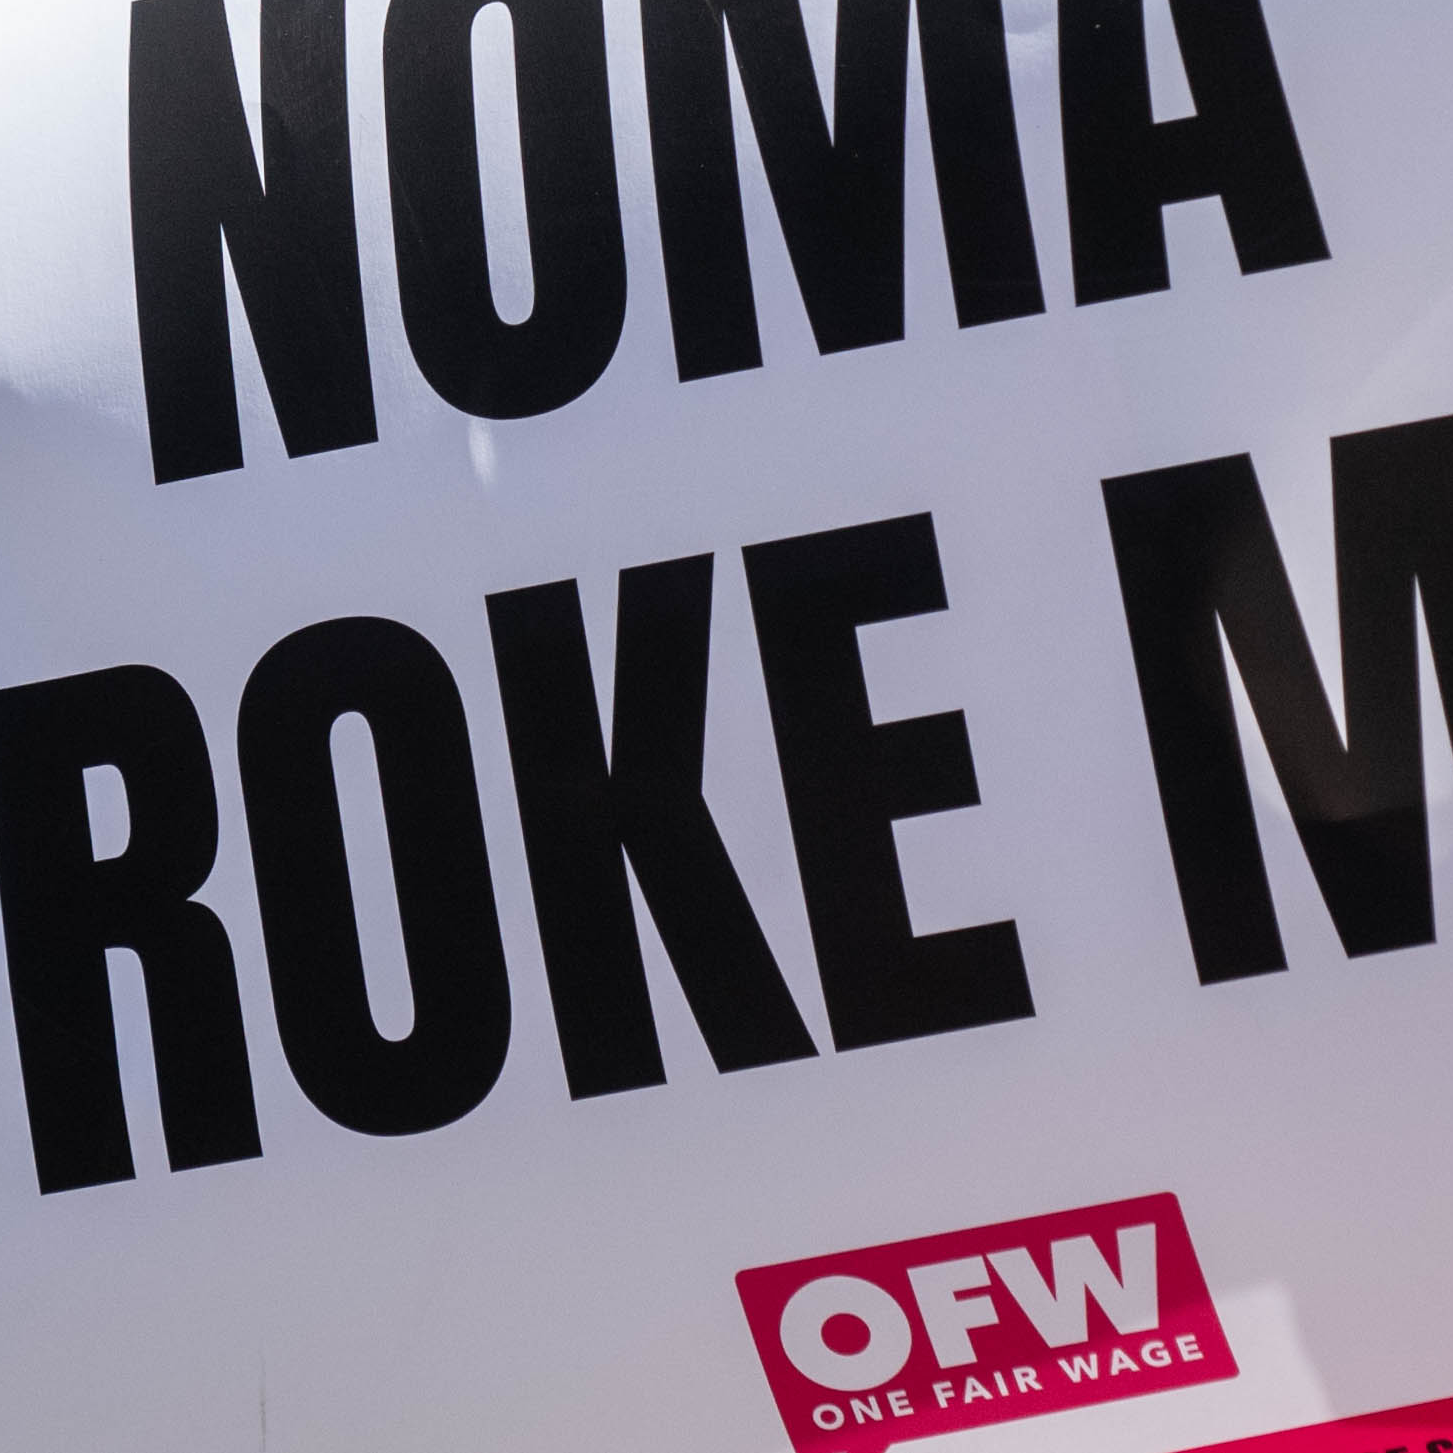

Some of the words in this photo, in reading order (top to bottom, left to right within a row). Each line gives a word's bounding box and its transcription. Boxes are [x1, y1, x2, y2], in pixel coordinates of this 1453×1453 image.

[778, 1222, 1160, 1393] OFW
[811, 1388, 916, 1432] ONE
[931, 1365, 1044, 1410] FAIR
[1056, 1333, 1205, 1384] WAGE
